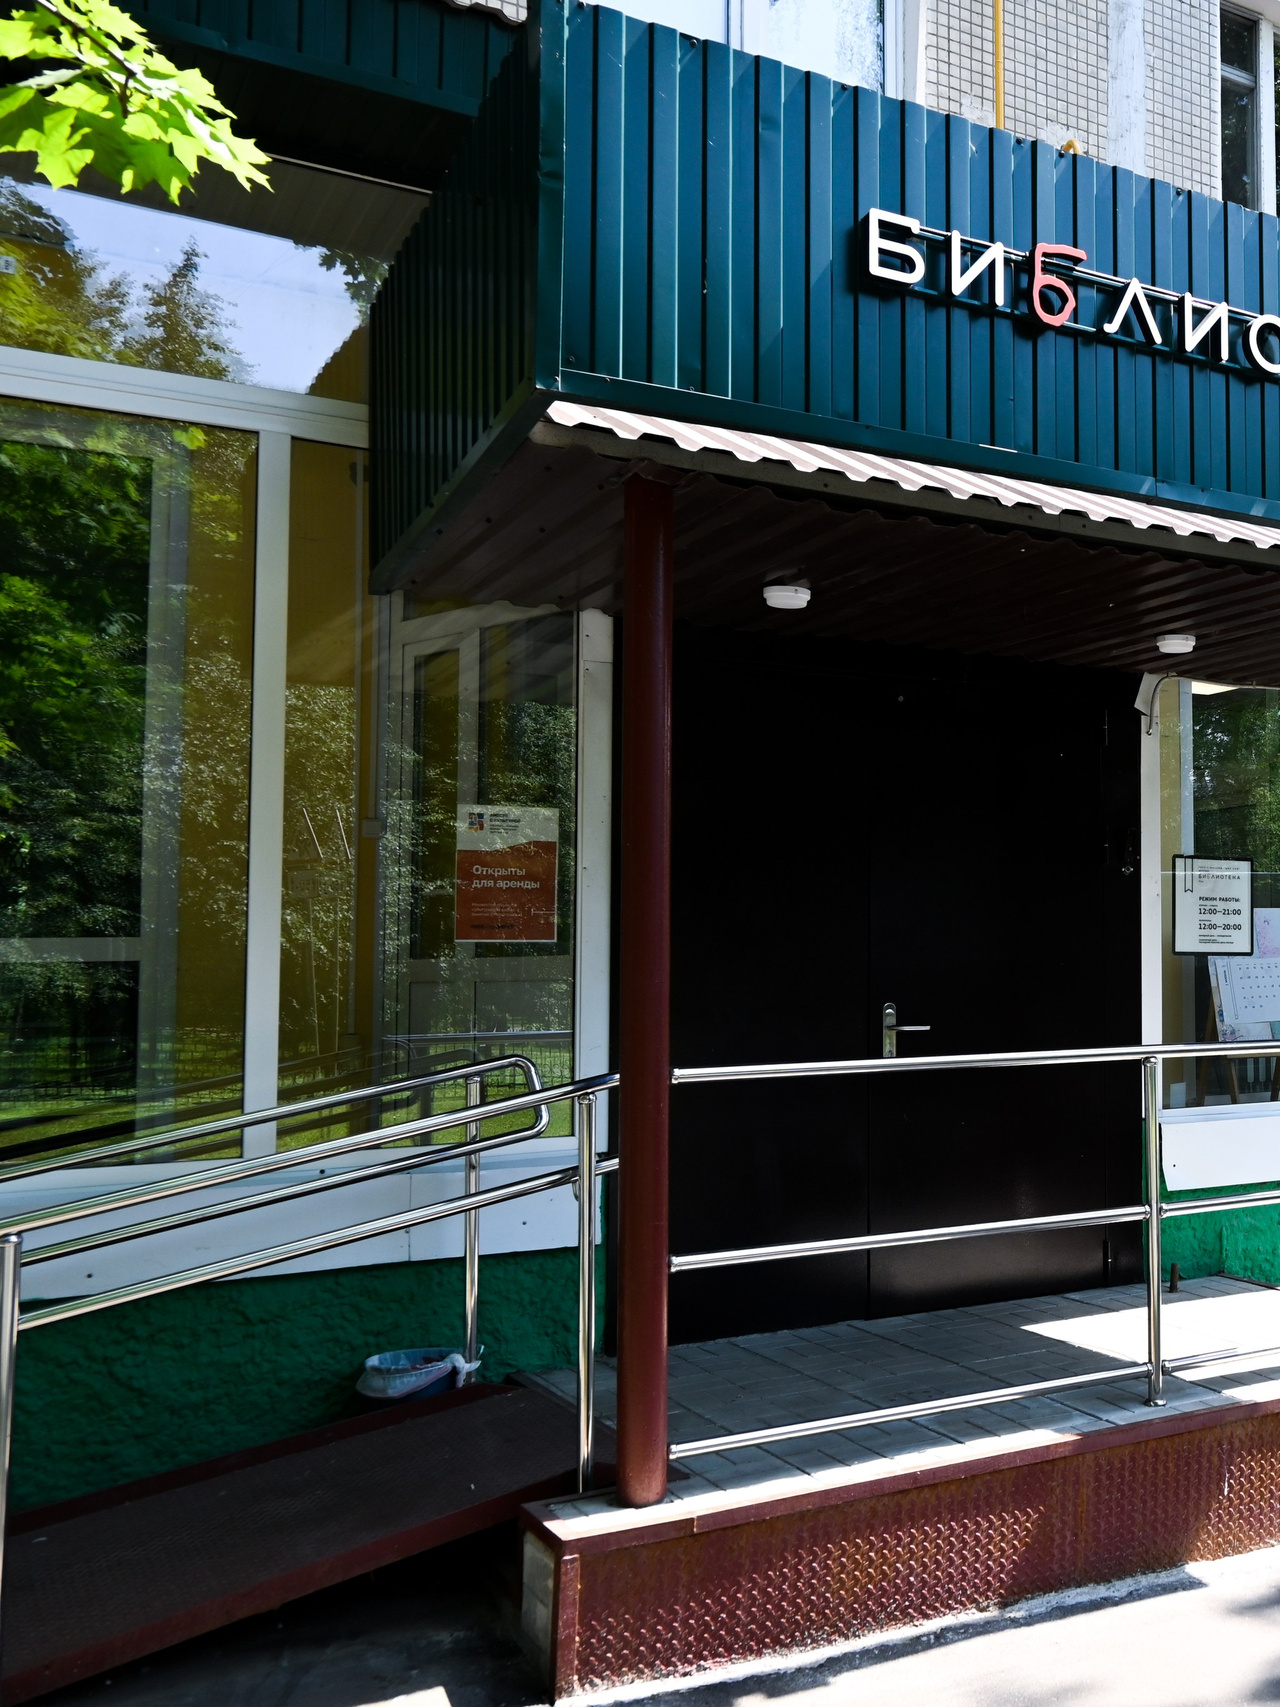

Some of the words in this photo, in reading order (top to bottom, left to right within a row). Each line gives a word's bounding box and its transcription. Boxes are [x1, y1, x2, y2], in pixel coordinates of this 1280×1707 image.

[472, 865, 526, 877] Открыты
[471, 879, 494, 889] для
[496, 879, 540, 890] аренды
